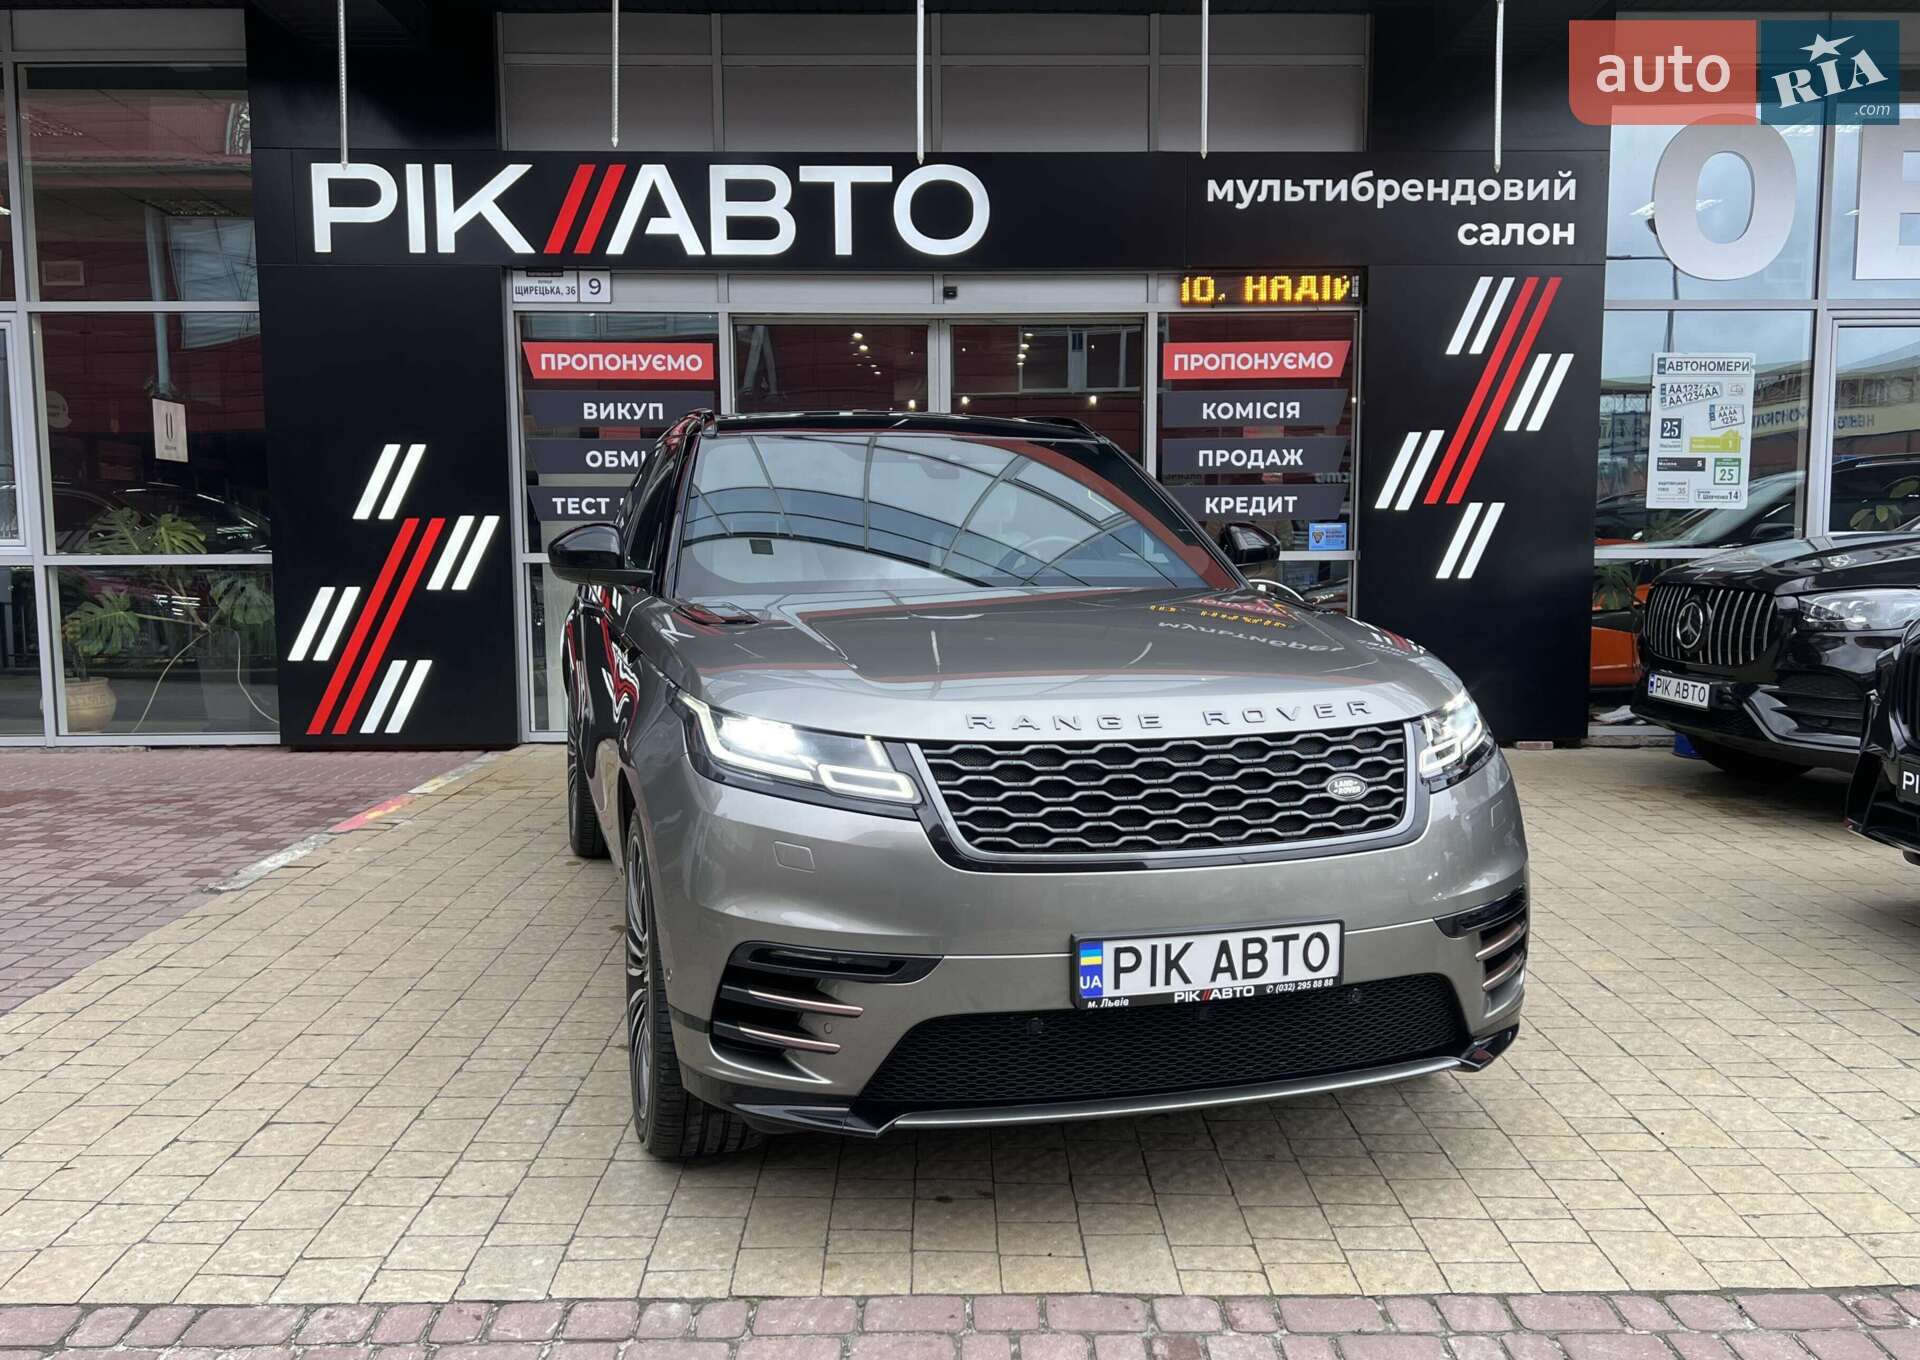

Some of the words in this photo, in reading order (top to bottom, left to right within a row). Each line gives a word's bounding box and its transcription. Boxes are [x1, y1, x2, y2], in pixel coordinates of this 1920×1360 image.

[1206, 170, 1576, 209] мультибрендовий
[1456, 221, 1575, 246] салон
[566, 286, 576, 295] 36
[588, 278, 602, 295] 9
[540, 353, 703, 371] ПРОПОНУЄМО
[1173, 352, 1333, 371] ПРОПОНУЄМО
[1667, 360, 1749, 372] АВТОНОМЕРИ
[583, 402, 664, 420] ВИКУП
[1202, 401, 1300, 420] КОМІСІЯ
[1663, 421, 1679, 437] 25
[1198, 449, 1304, 469] ПРОДАЖ
[1719, 469, 1734, 481] 25
[1728, 491, 1739, 500] 14
[552, 497, 610, 515] ТЕСТ
[1205, 496, 1298, 516] КРЕДИТ
[966, 713, 1163, 731] RANGE
[1202, 701, 1371, 726] ROVER
[1080, 974, 1102, 990] UA
[1275, 984, 1296, 994] (032)
[1297, 981, 1312, 990] 295
[1312, 979, 1322, 988] 88
[1323, 978, 1334, 986] 88
[1100, 998, 1130, 1008] Львів
